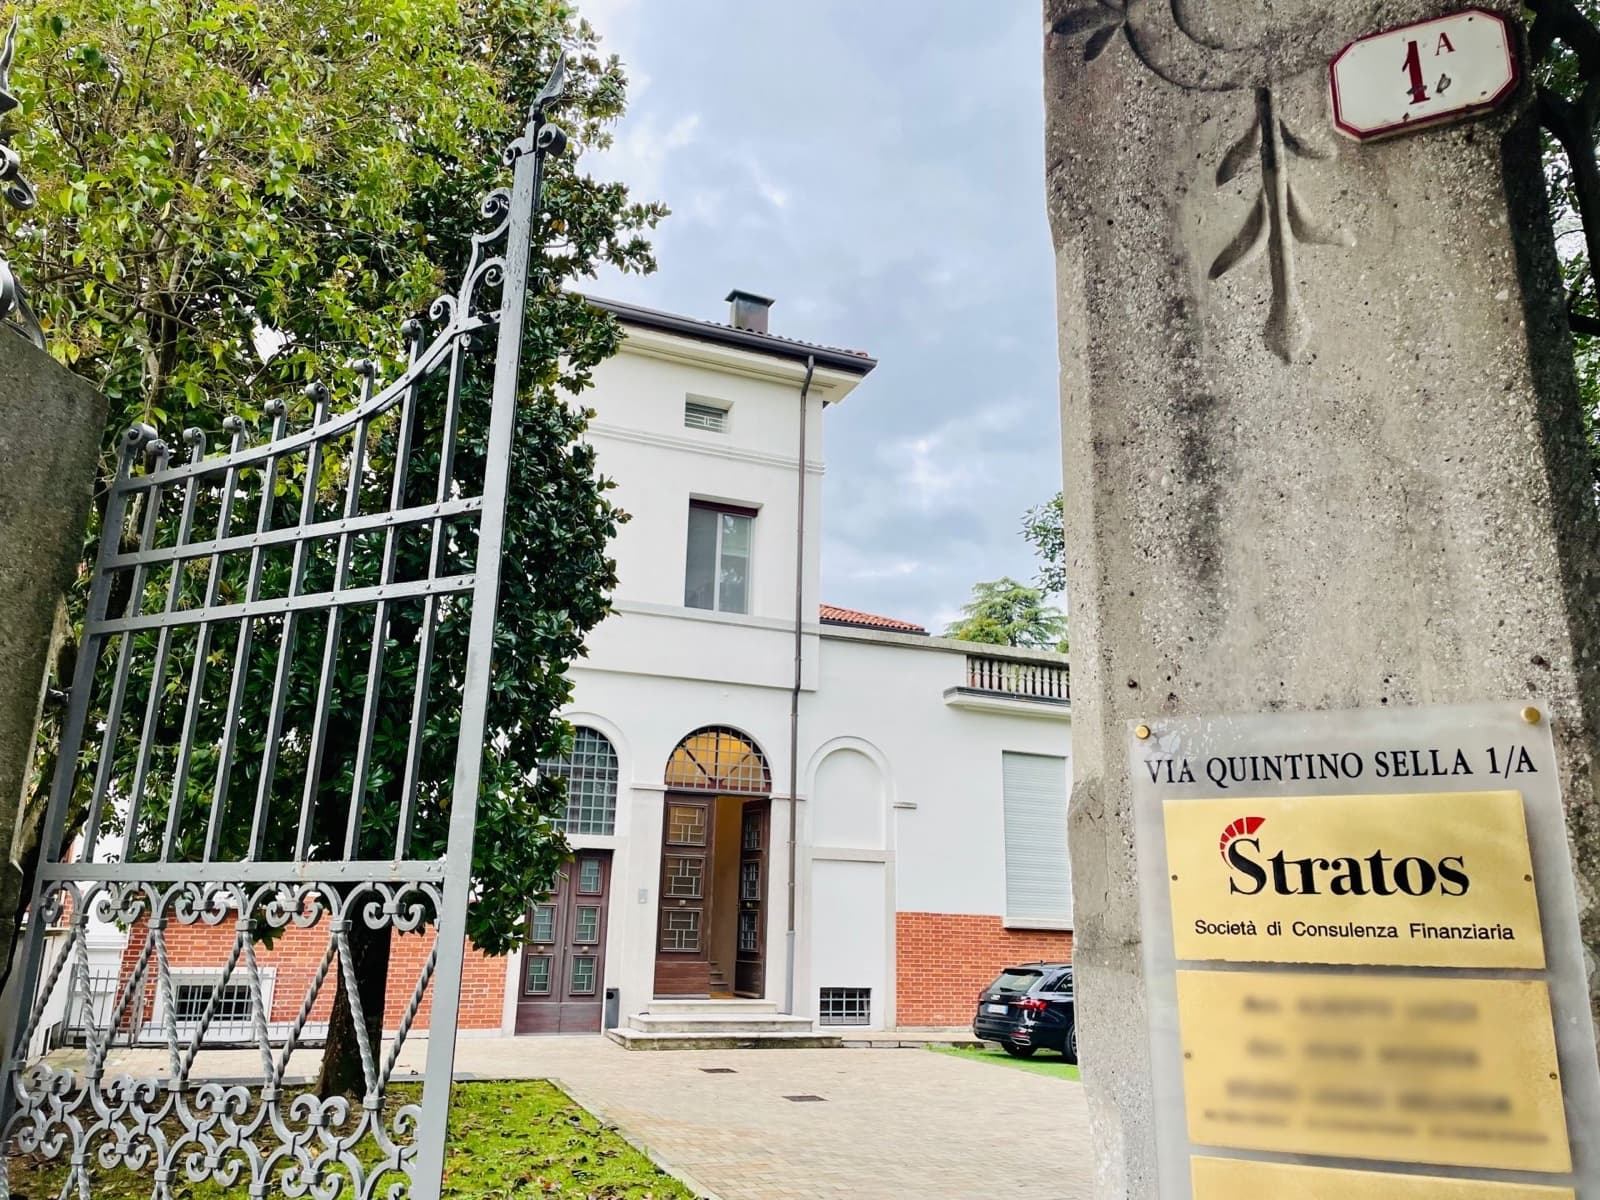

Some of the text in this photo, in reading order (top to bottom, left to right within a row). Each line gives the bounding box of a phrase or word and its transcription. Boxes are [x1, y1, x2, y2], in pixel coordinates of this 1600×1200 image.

[1144, 744, 1538, 788] VIA QUINTINO SELLA 1/A
[1227, 837, 1471, 897] Stratos
[1194, 919, 1515, 941] Società di Consulenza Finanziaria
